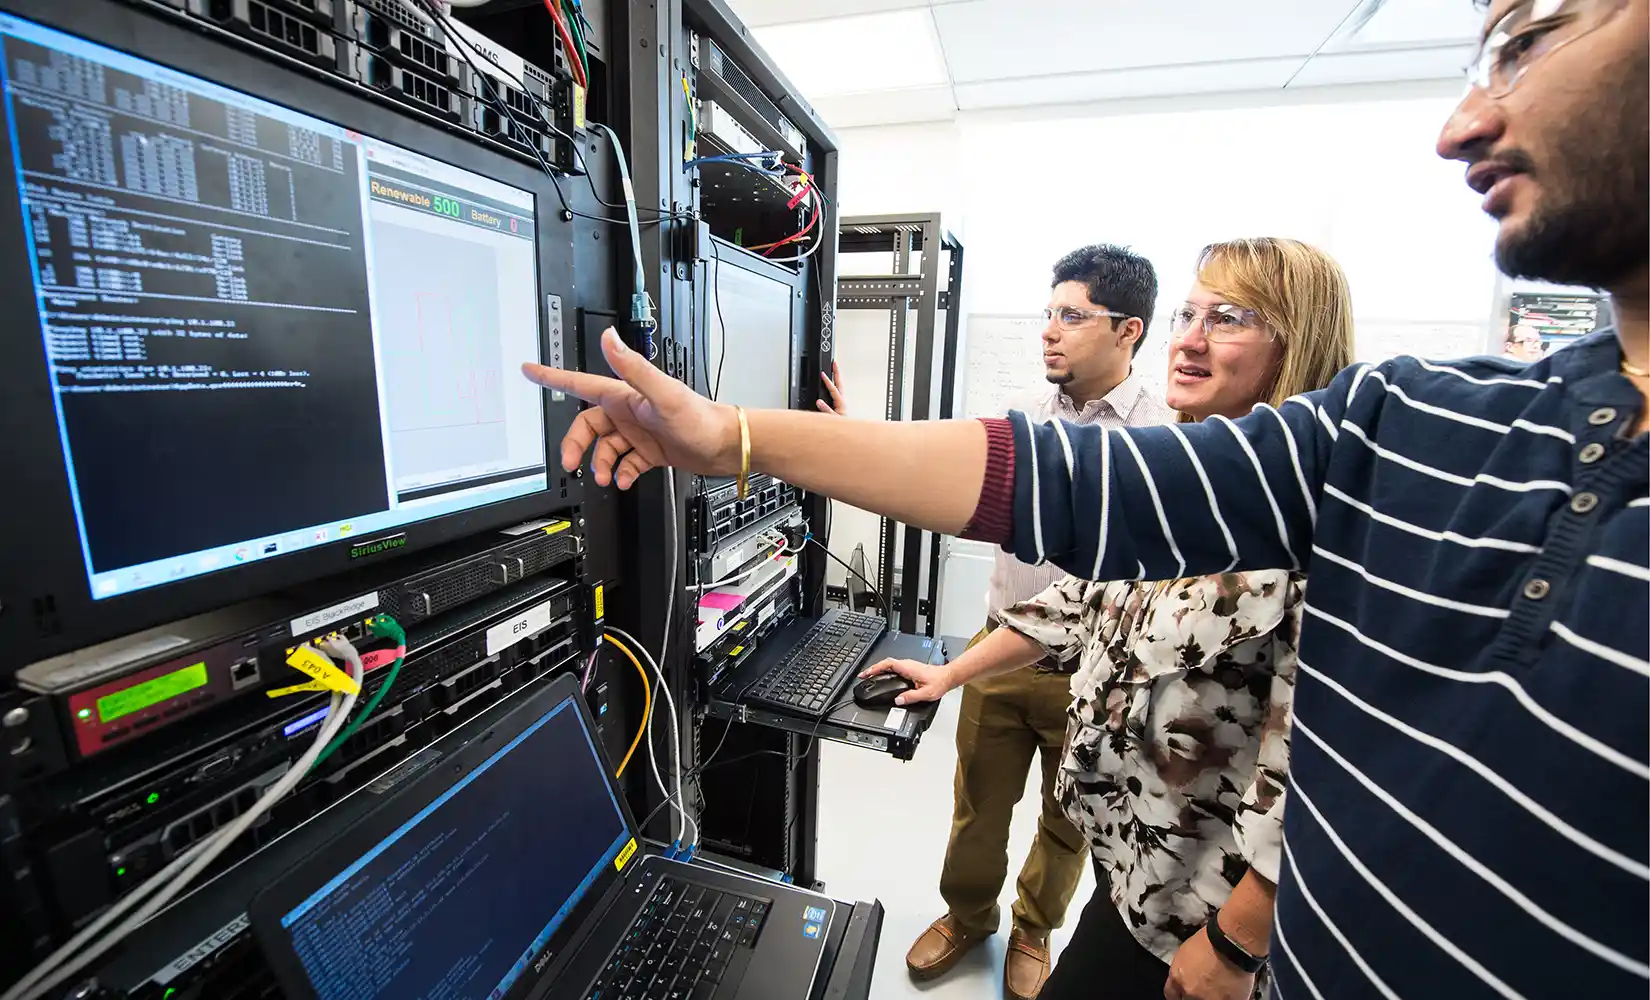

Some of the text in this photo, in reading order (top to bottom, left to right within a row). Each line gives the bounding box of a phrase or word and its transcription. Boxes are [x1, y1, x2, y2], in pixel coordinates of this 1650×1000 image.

[370, 180, 430, 208] Renewable
[433, 195, 460, 217] 500
[471, 209, 501, 229] Battery
[351, 538, 406, 558] SiriusView
[305, 602, 366, 627] EIS BlackRidge
[513, 620, 528, 634] EIS
